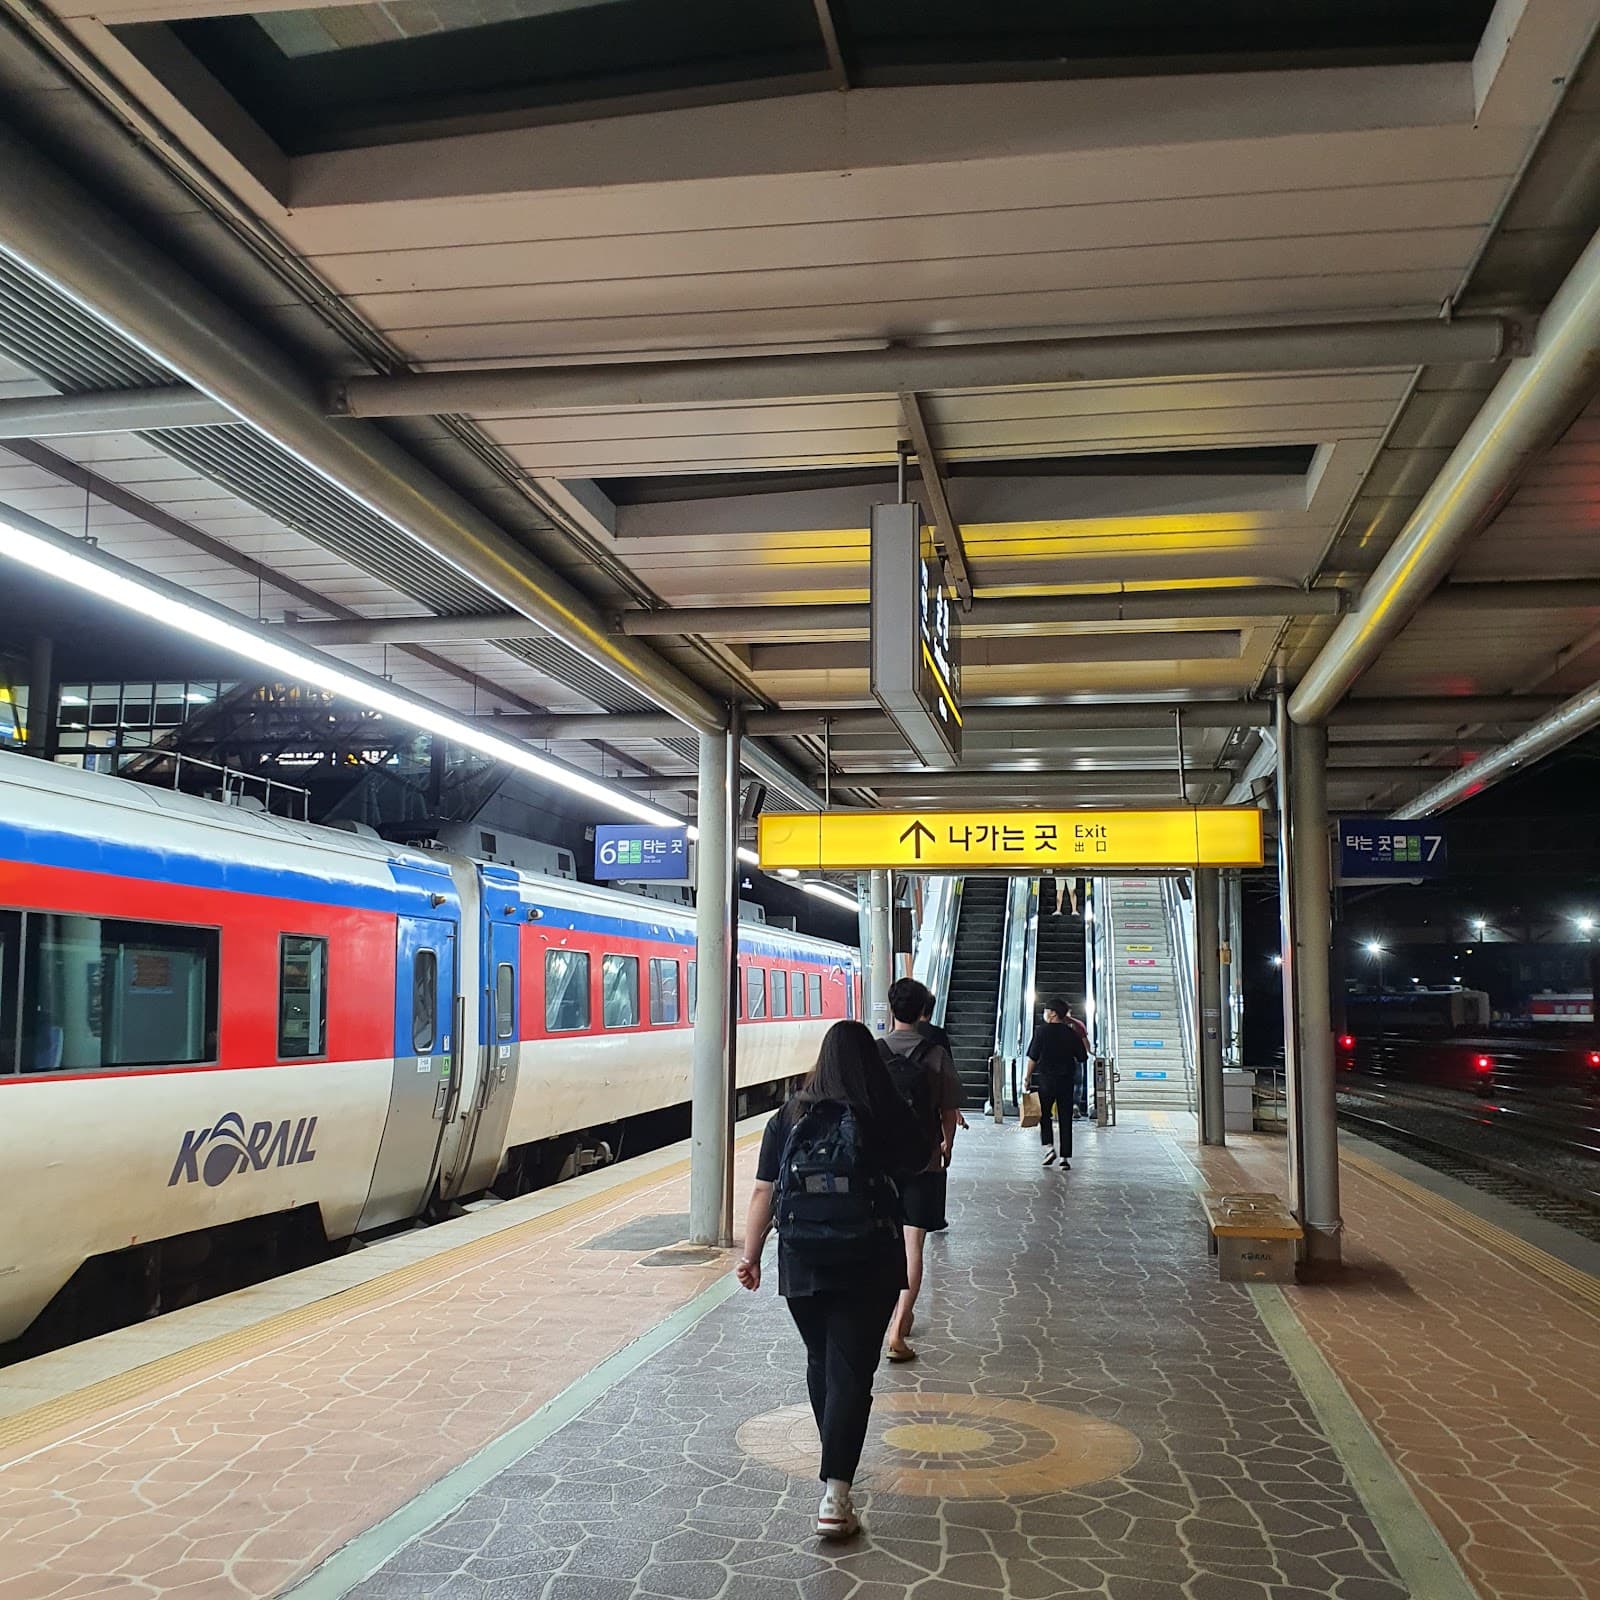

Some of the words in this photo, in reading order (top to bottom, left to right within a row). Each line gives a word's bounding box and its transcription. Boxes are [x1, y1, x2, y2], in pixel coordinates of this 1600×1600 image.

[949, 825, 1024, 851] 나가는
[1035, 825, 1057, 851] 곳
[1074, 824, 1107, 838] Exit
[600, 840, 616, 865] 6
[643, 839, 667, 854] 타는
[671, 839, 682, 854] 곳
[1346, 835, 1373, 851] 타는
[1378, 835, 1391, 851] 곳
[1423, 836, 1442, 861] 7
[167, 1111, 318, 1187] KORAIL
